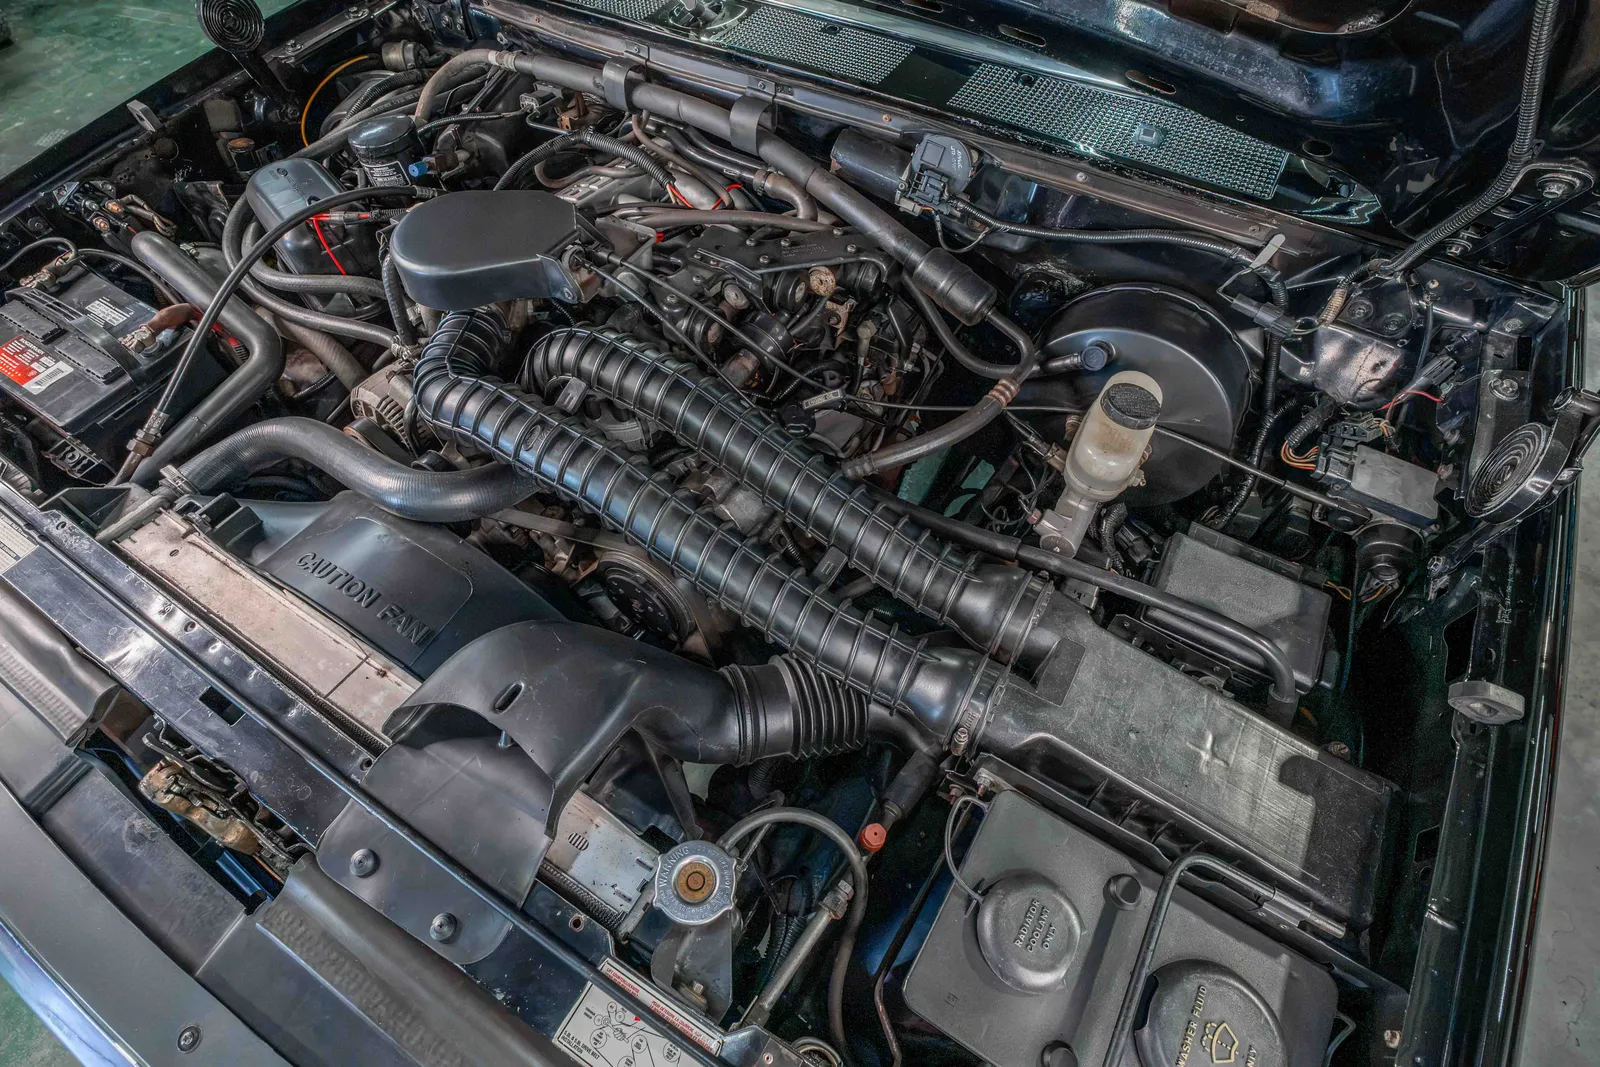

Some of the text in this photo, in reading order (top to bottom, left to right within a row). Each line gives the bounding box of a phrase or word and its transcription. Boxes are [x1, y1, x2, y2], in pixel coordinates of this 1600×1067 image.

[296, 552, 434, 645] CAUTION FAN
[659, 846, 689, 888] WARNING
[1014, 899, 1040, 948] RADIATOR
[1027, 907, 1050, 953] COOLANT
[1042, 923, 1057, 950] ONLY
[1175, 985, 1207, 1067] WASHER FLUID
[580, 1043, 592, 1054] DRIVE
[590, 1050, 600, 1060] BELT
[1246, 1046, 1257, 1067] NLY
